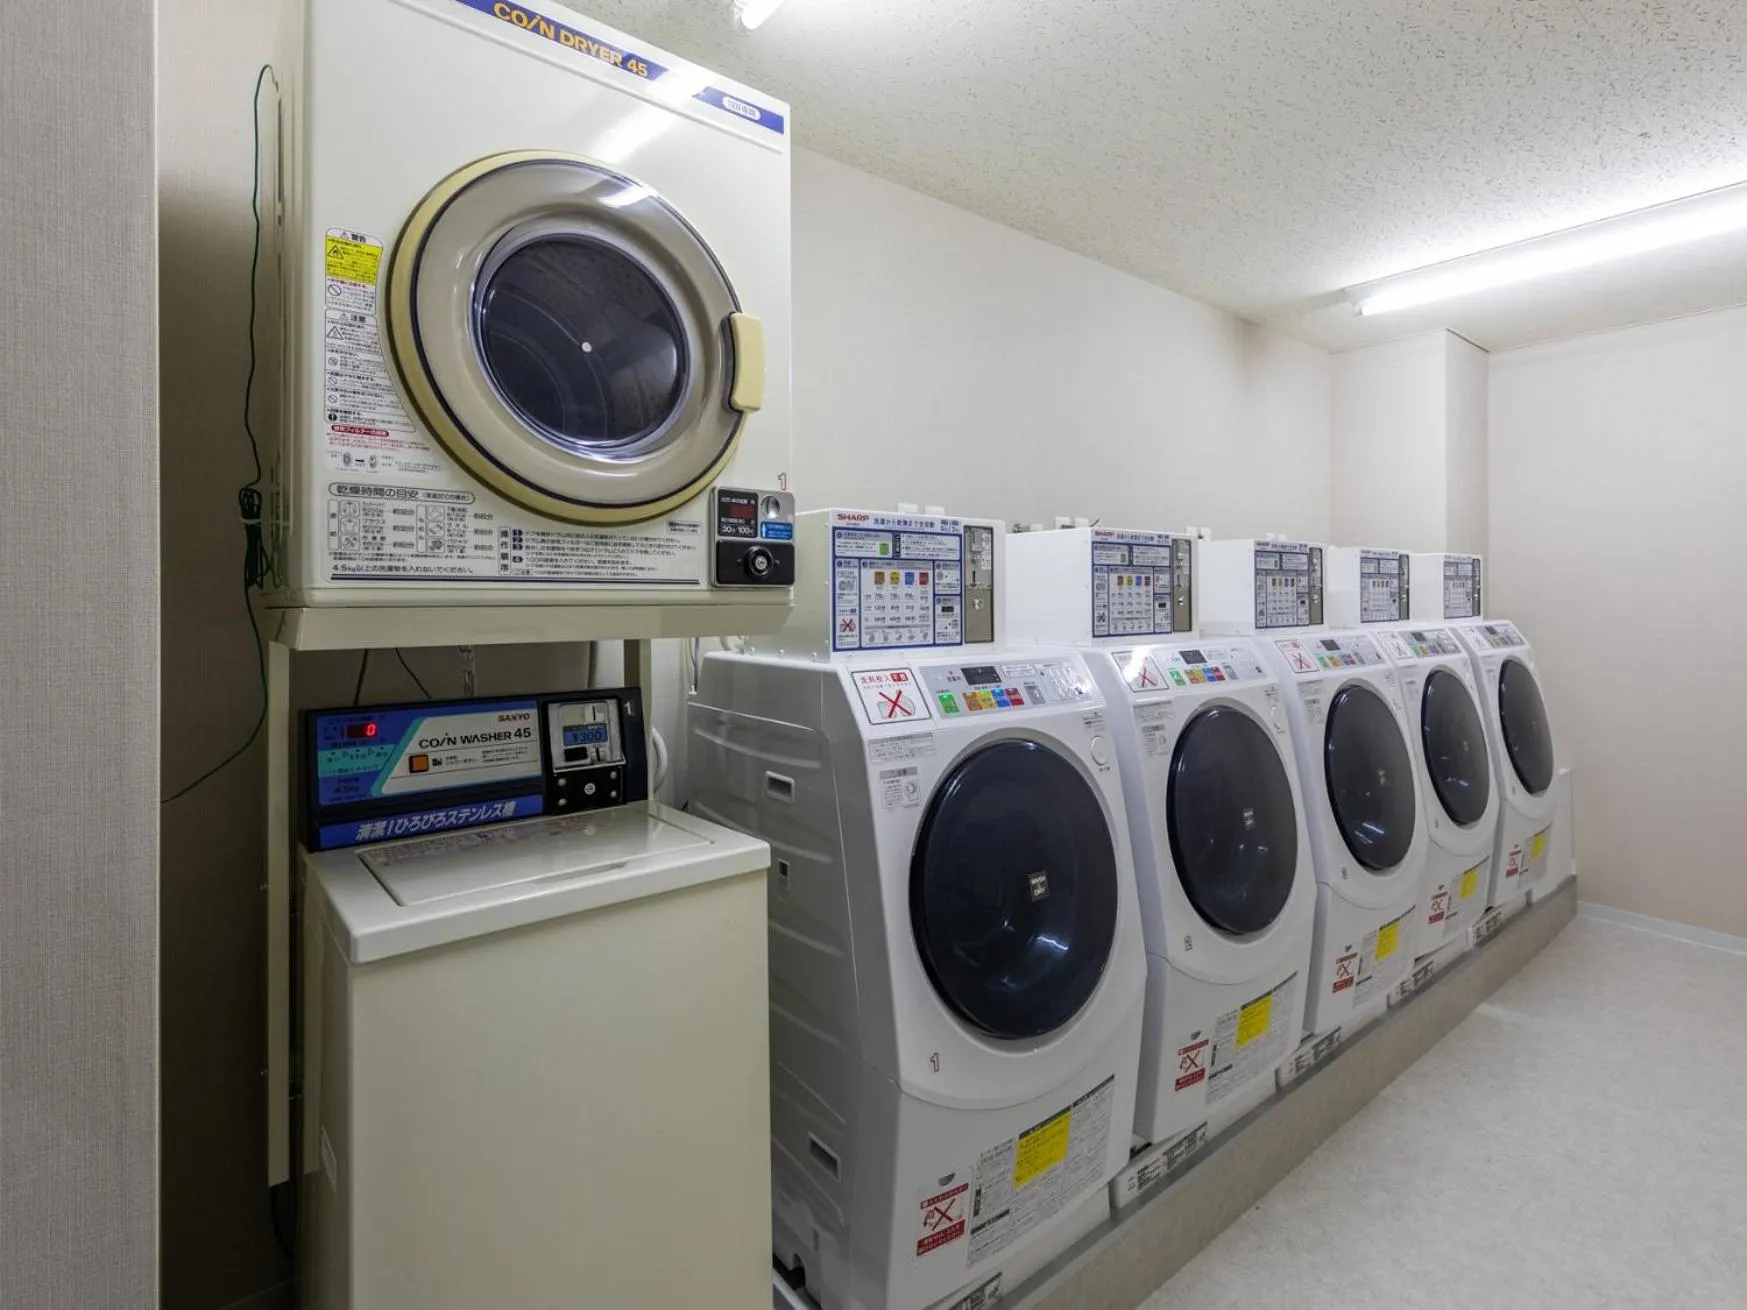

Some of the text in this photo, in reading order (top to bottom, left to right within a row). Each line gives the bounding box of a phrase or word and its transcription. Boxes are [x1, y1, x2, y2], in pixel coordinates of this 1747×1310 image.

[559, 29, 624, 67] DRYER
[627, 59, 649, 78] 45
[777, 472, 788, 491] 1
[336, 485, 418, 499] 乾燥時間の目安
[836, 513, 869, 522] SHARP
[624, 701, 633, 716] 1
[498, 712, 530, 723] SANYO
[366, 723, 377, 736] 0
[460, 731, 512, 745] WASHER
[514, 728, 532, 739] 45
[930, 1052, 940, 1072] 1
